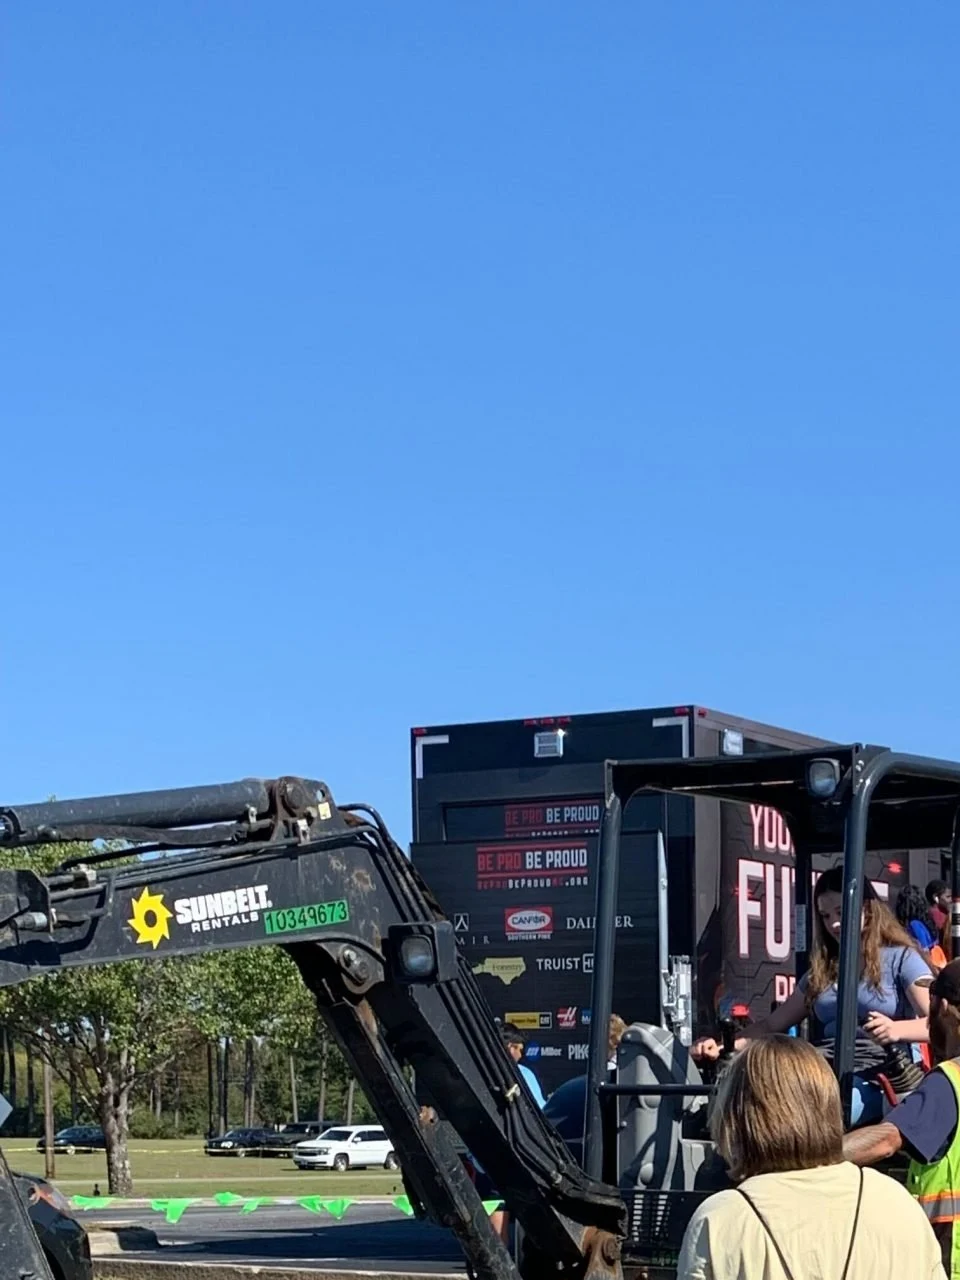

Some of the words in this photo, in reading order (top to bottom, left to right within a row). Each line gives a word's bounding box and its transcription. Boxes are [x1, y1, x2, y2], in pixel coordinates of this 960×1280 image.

[546, 807, 560, 823] BE
[564, 805, 599, 821] PROUD
[750, 804, 796, 853] YOU
[478, 853, 494, 871] BE
[497, 852, 521, 870] PRO
[525, 851, 542, 869] BE
[546, 849, 588, 868] PROUD
[174, 884, 269, 925] SUNBELT
[191, 911, 259, 933] RENTALS
[266, 902, 348, 932] 10349673
[536, 958, 580, 971] TRUIST
